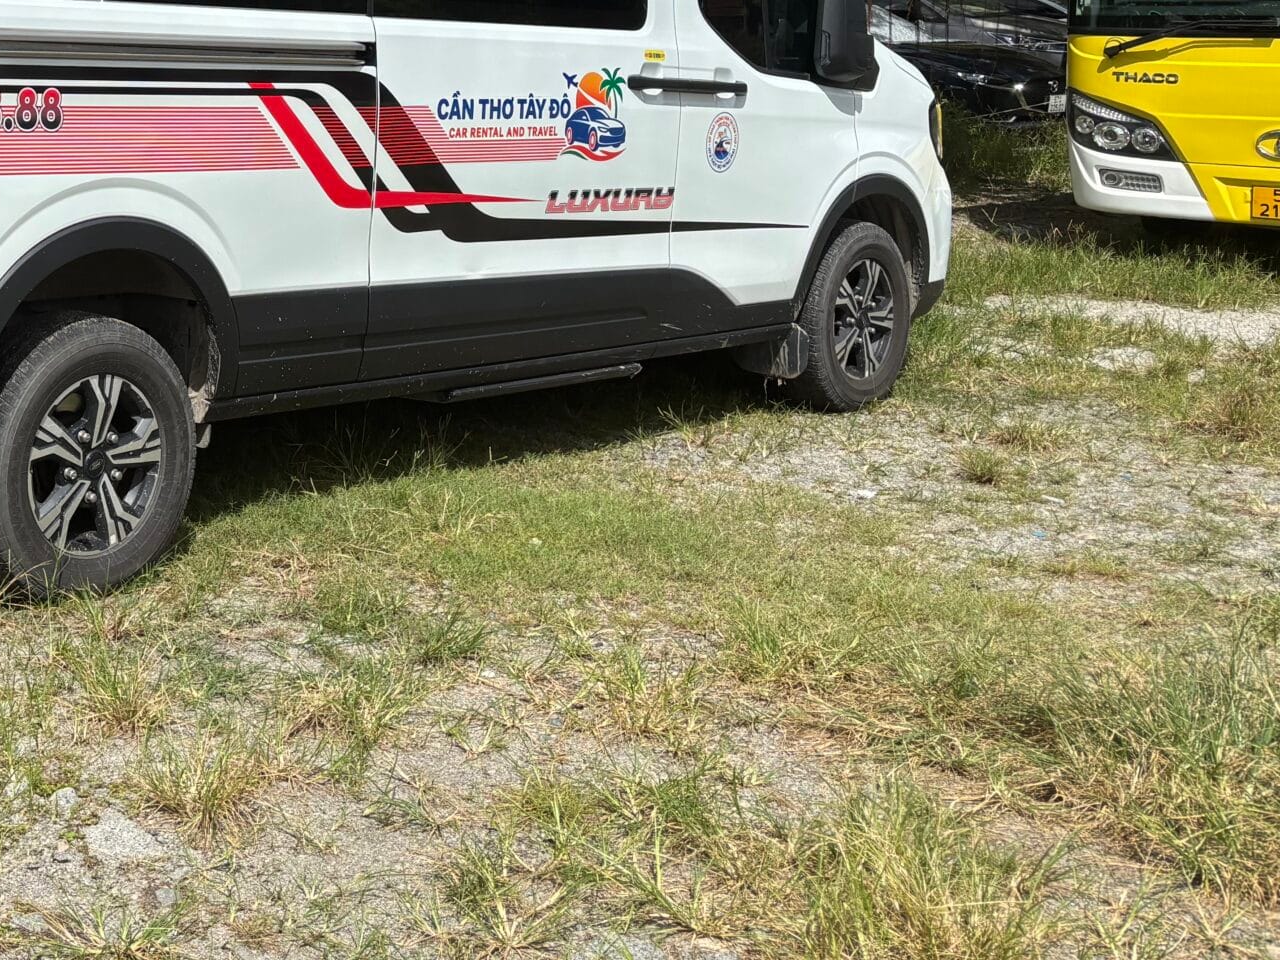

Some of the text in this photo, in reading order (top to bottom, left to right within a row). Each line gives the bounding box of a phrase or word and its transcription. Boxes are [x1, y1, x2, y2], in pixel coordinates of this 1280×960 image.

[1112, 72, 1179, 84] THACO
[437, 91, 570, 120] CẦN THƠ TÂY ĐÔ
[449, 126, 558, 139] CAR RENTAL AND TRAVEL
[545, 186, 675, 214] LUXURY
